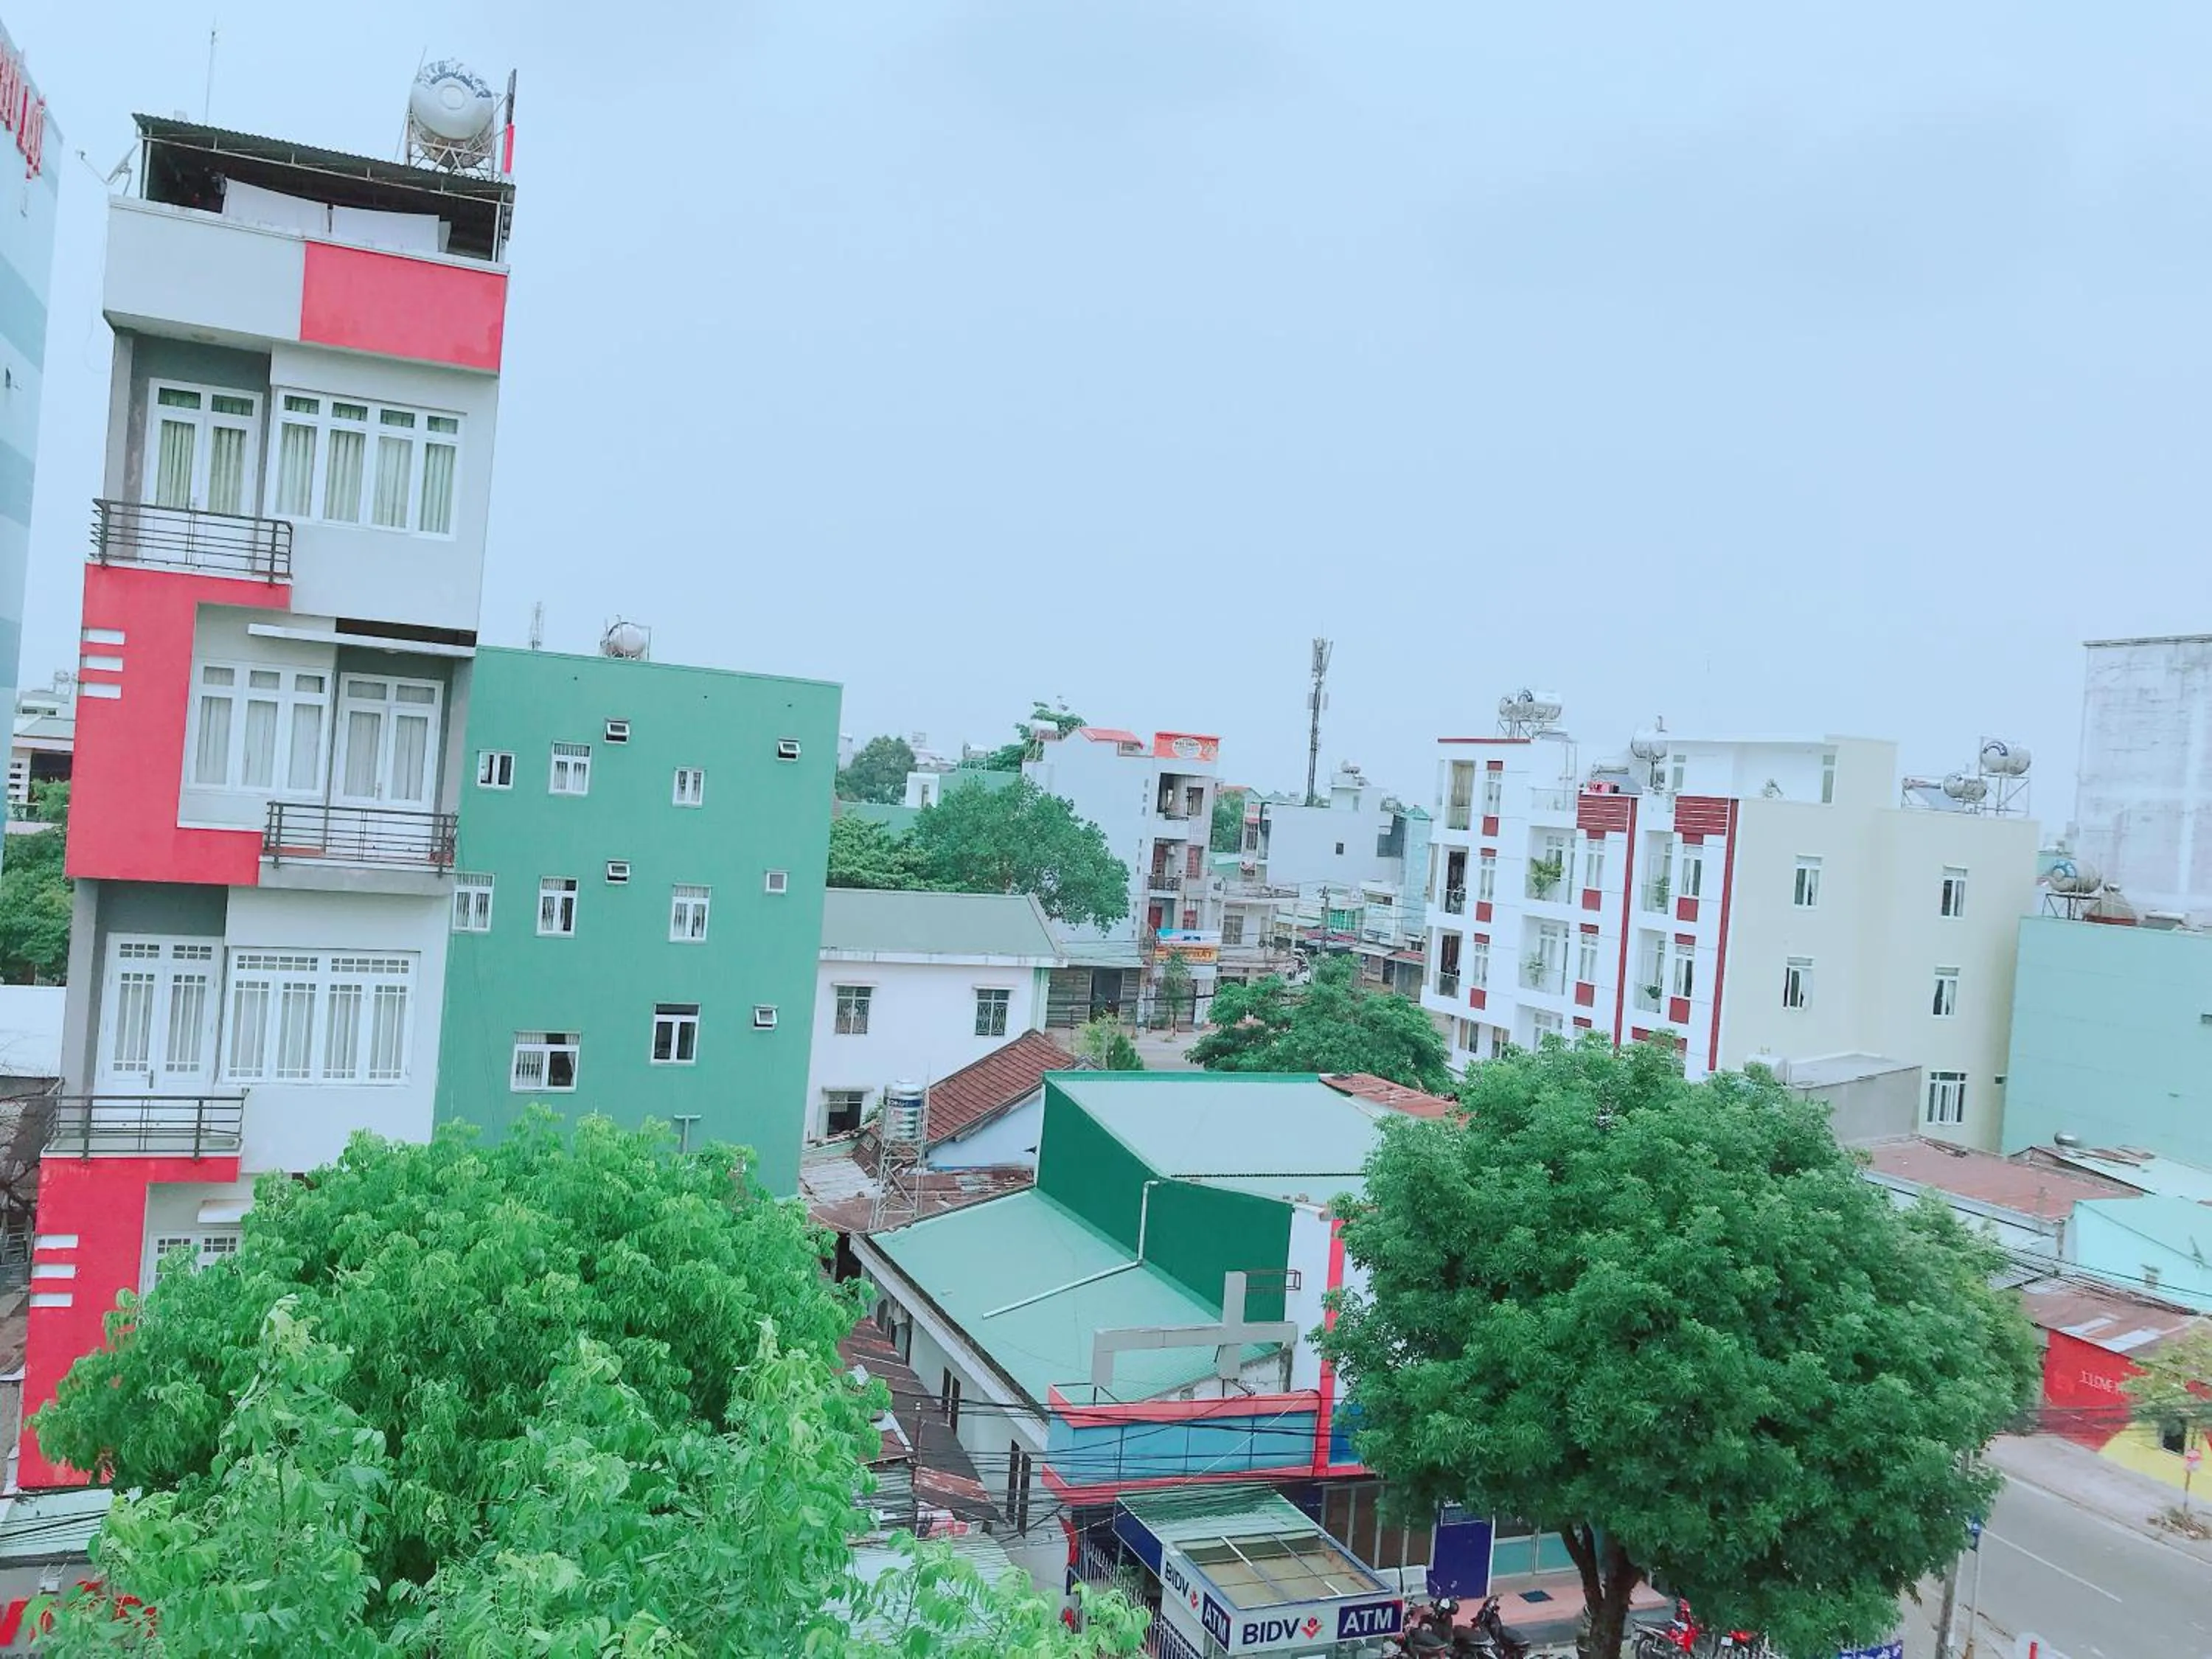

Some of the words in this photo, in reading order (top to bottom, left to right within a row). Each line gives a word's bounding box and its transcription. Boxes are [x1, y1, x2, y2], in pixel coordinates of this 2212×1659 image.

[1165, 1561, 1189, 1598] BIDV
[1204, 1603, 1228, 1643] ATM
[1242, 1617, 1301, 1645] BIDV
[1343, 1607, 1393, 1634] ATM
